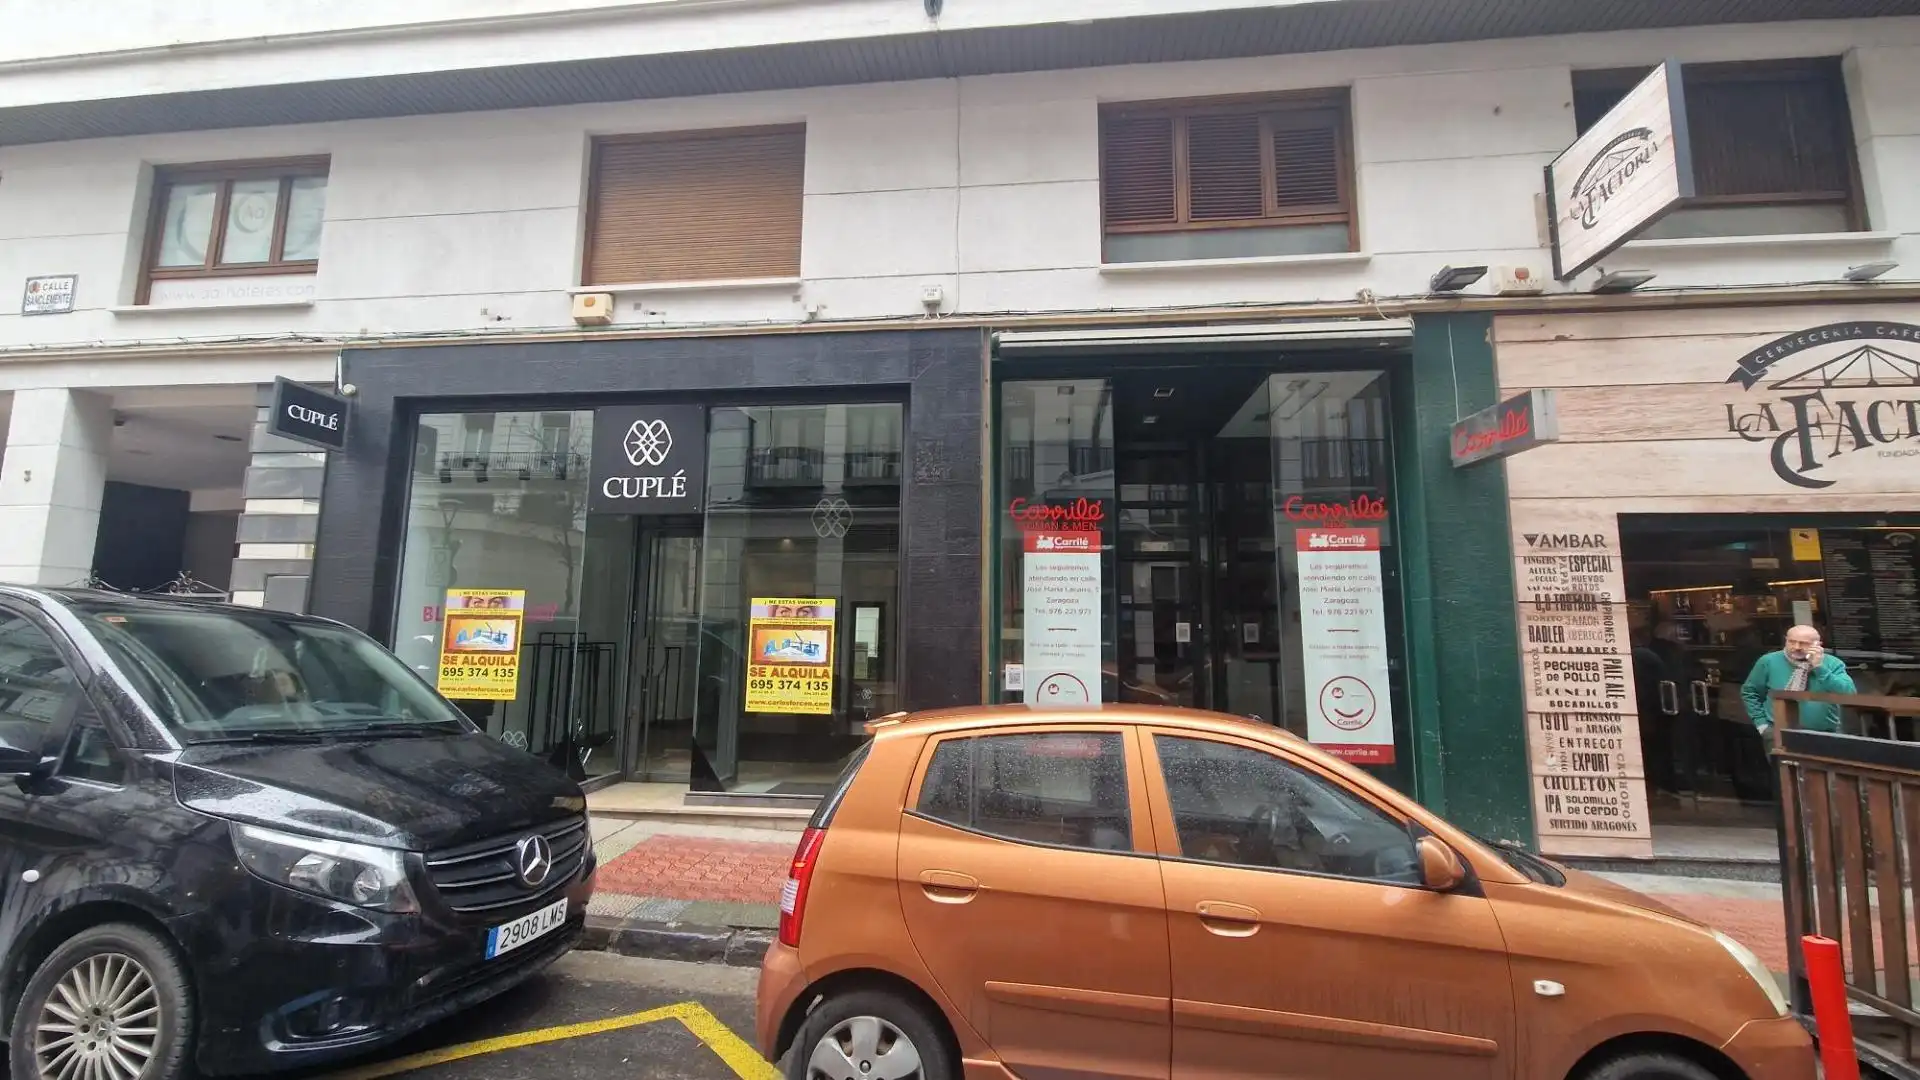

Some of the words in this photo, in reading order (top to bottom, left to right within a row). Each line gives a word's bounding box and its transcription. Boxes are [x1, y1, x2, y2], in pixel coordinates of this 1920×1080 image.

[42, 281, 69, 291] CALLE
[287, 404, 339, 431] CUPLÉ
[1725, 402, 1781, 442] LA
[602, 468, 687, 499] CUPLÉ
[1009, 496, 1105, 521] Carrilé
[1283, 494, 1389, 521] Carrilé
[1062, 521, 1069, 531] &
[1072, 521, 1097, 531] MEN
[1054, 536, 1089, 546] Carrilé
[1327, 534, 1367, 545] Carrilé
[1539, 534, 1607, 549] AMBAR
[1569, 555, 1614, 573] ESPECIAL
[1529, 567, 1557, 575] ALITAS
[1571, 575, 1605, 583] HUEVOS
[1572, 583, 1601, 592] ROTOS
[1046, 597, 1080, 605] Zaragoza
[1323, 596, 1360, 605] Zaragoza
[1528, 625, 1566, 644] RADLER
[1543, 645, 1619, 655] CALAMARES
[442, 655, 458, 666] SE
[462, 656, 517, 667] ALQUILA
[442, 667, 464, 677] 695
[467, 668, 489, 677] 374
[492, 668, 514, 678] 135
[749, 666, 766, 677] SE
[771, 667, 830, 679] ALQUILA
[1563, 672, 1601, 683] POLLO
[750, 679, 773, 689] 695
[778, 680, 801, 690] 374
[806, 681, 829, 691] 135
[1604, 681, 1627, 700] ALE
[1549, 700, 1620, 710] BOCADILLOS
[1539, 712, 1570, 732] 1900
[1559, 738, 1624, 750] ENTRECOT
[1572, 753, 1610, 773] EXPORT
[1543, 775, 1617, 792] CHULETÓN
[1616, 754, 1632, 819] CACHOPO
[1545, 795, 1562, 815] IPA
[1549, 818, 1589, 830] SURTIDO
[499, 915, 539, 949] 2908
[541, 903, 565, 931] LMS
